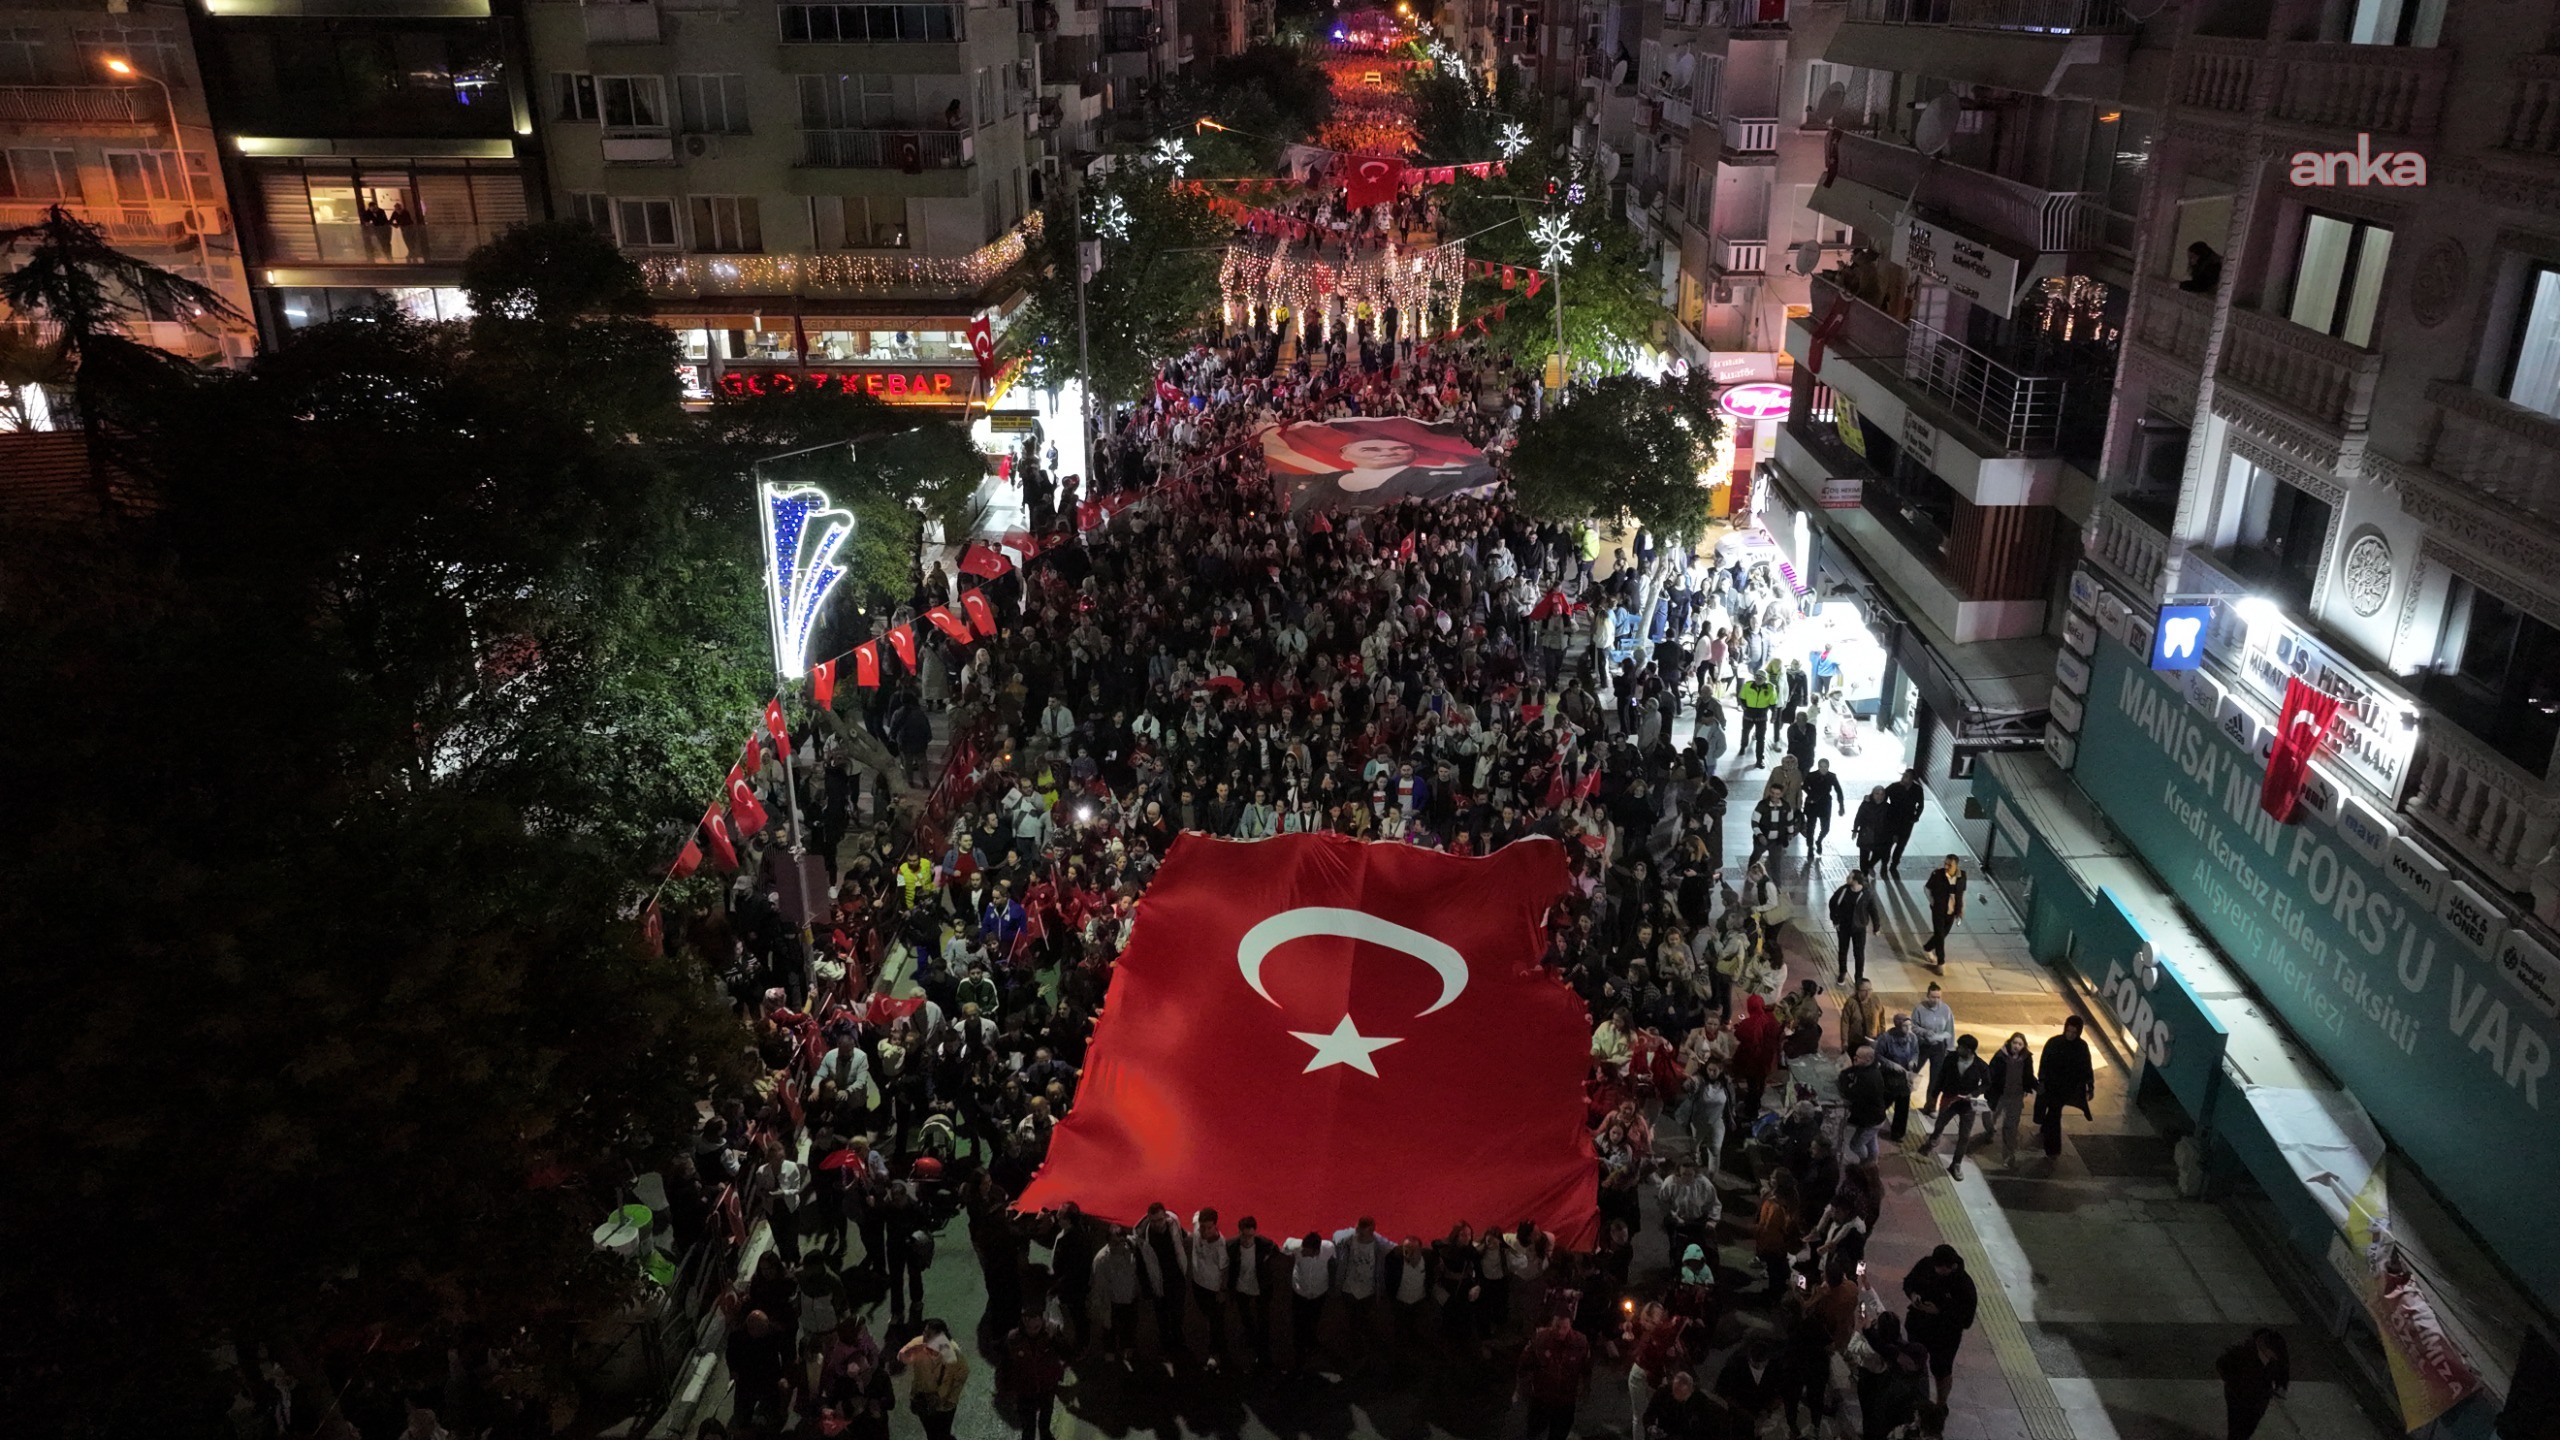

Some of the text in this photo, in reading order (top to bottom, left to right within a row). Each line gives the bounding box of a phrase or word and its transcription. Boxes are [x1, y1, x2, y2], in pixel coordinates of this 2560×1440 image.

[840, 319, 879, 330] KEBAP
[883, 319, 932, 331] SALONU
[719, 373, 828, 396] GEDZ
[2224, 722, 2245, 746] adidas
[2344, 813, 2382, 850] mavi
[2163, 780, 2421, 1055] Kredi Kartsız Elden Taksitli
[2446, 908, 2485, 947] JONES
[2191, 858, 2346, 1038] Alışveriş Merkezi
[2287, 826, 2436, 993] FORS'U
[2450, 963, 2550, 1111] VAR
[2102, 958, 2169, 1067] FORS
